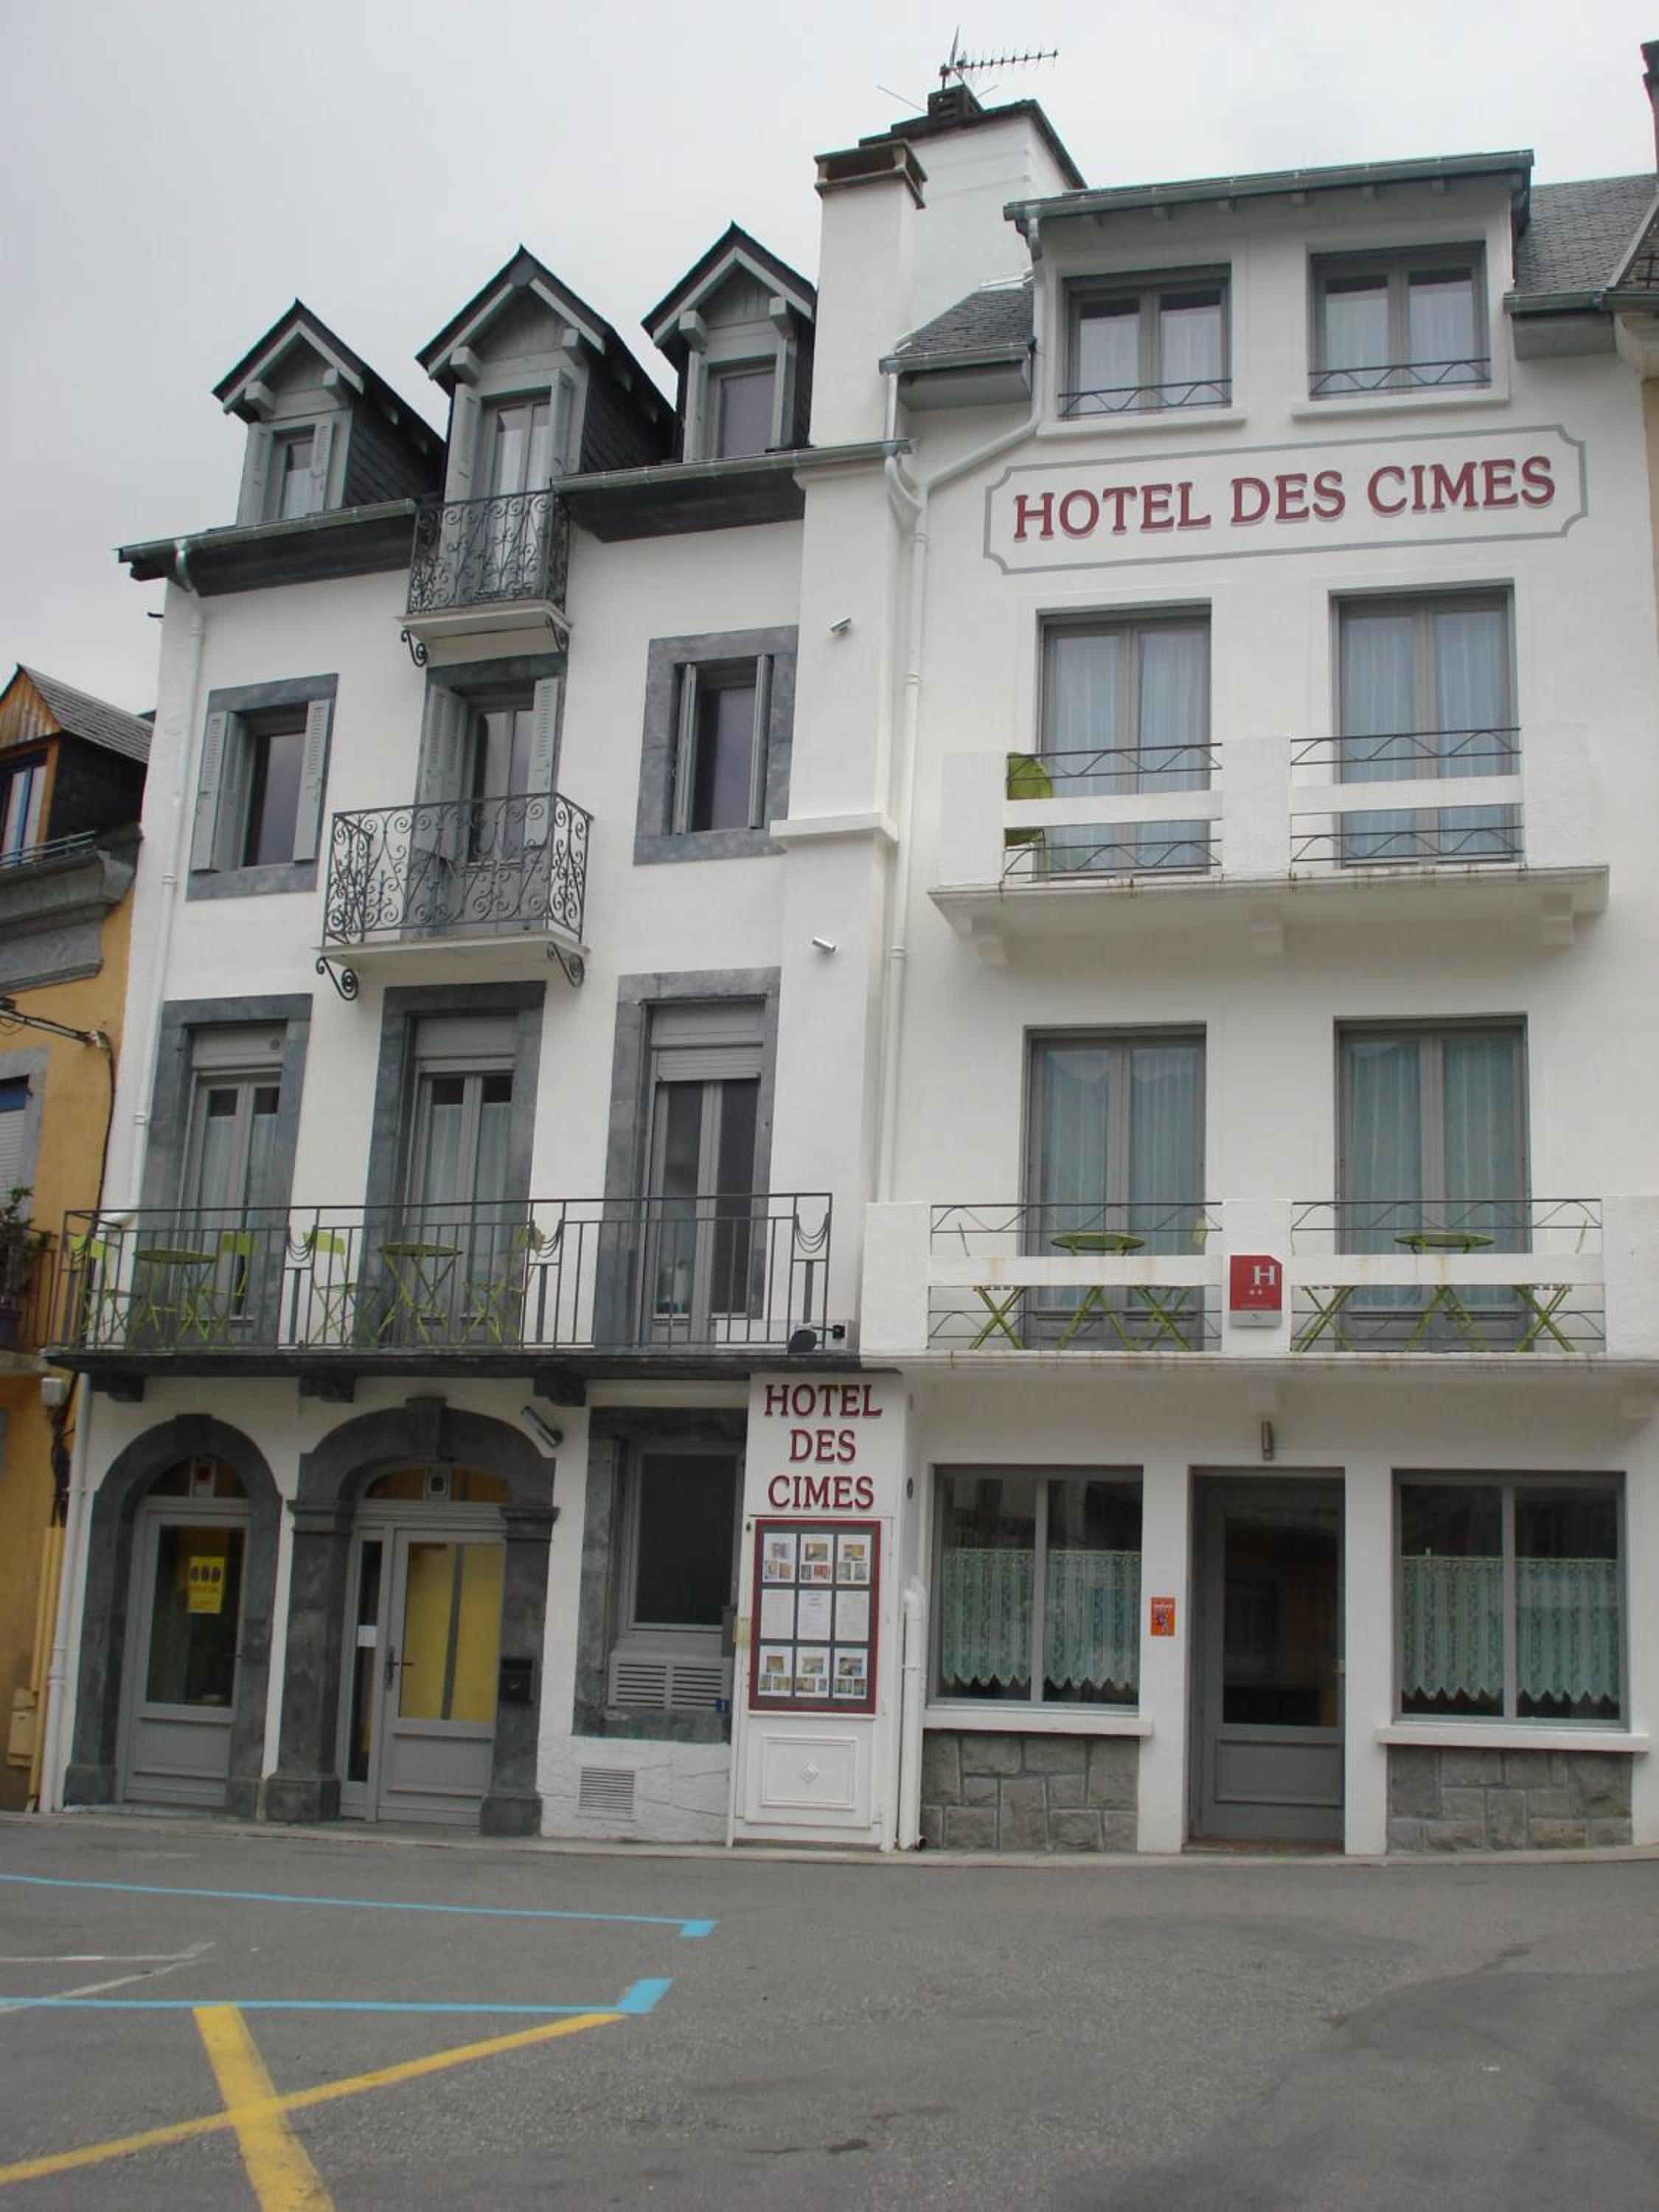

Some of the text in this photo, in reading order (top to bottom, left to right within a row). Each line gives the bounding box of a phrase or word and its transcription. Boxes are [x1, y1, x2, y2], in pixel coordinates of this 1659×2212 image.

[1013, 456, 1556, 541] HOTEL DES CIMES
[1253, 1265, 1275, 1286] H
[765, 1383, 883, 1417] HOTEL
[789, 1428, 856, 1463] DES
[768, 1475, 874, 1509] CIMES
